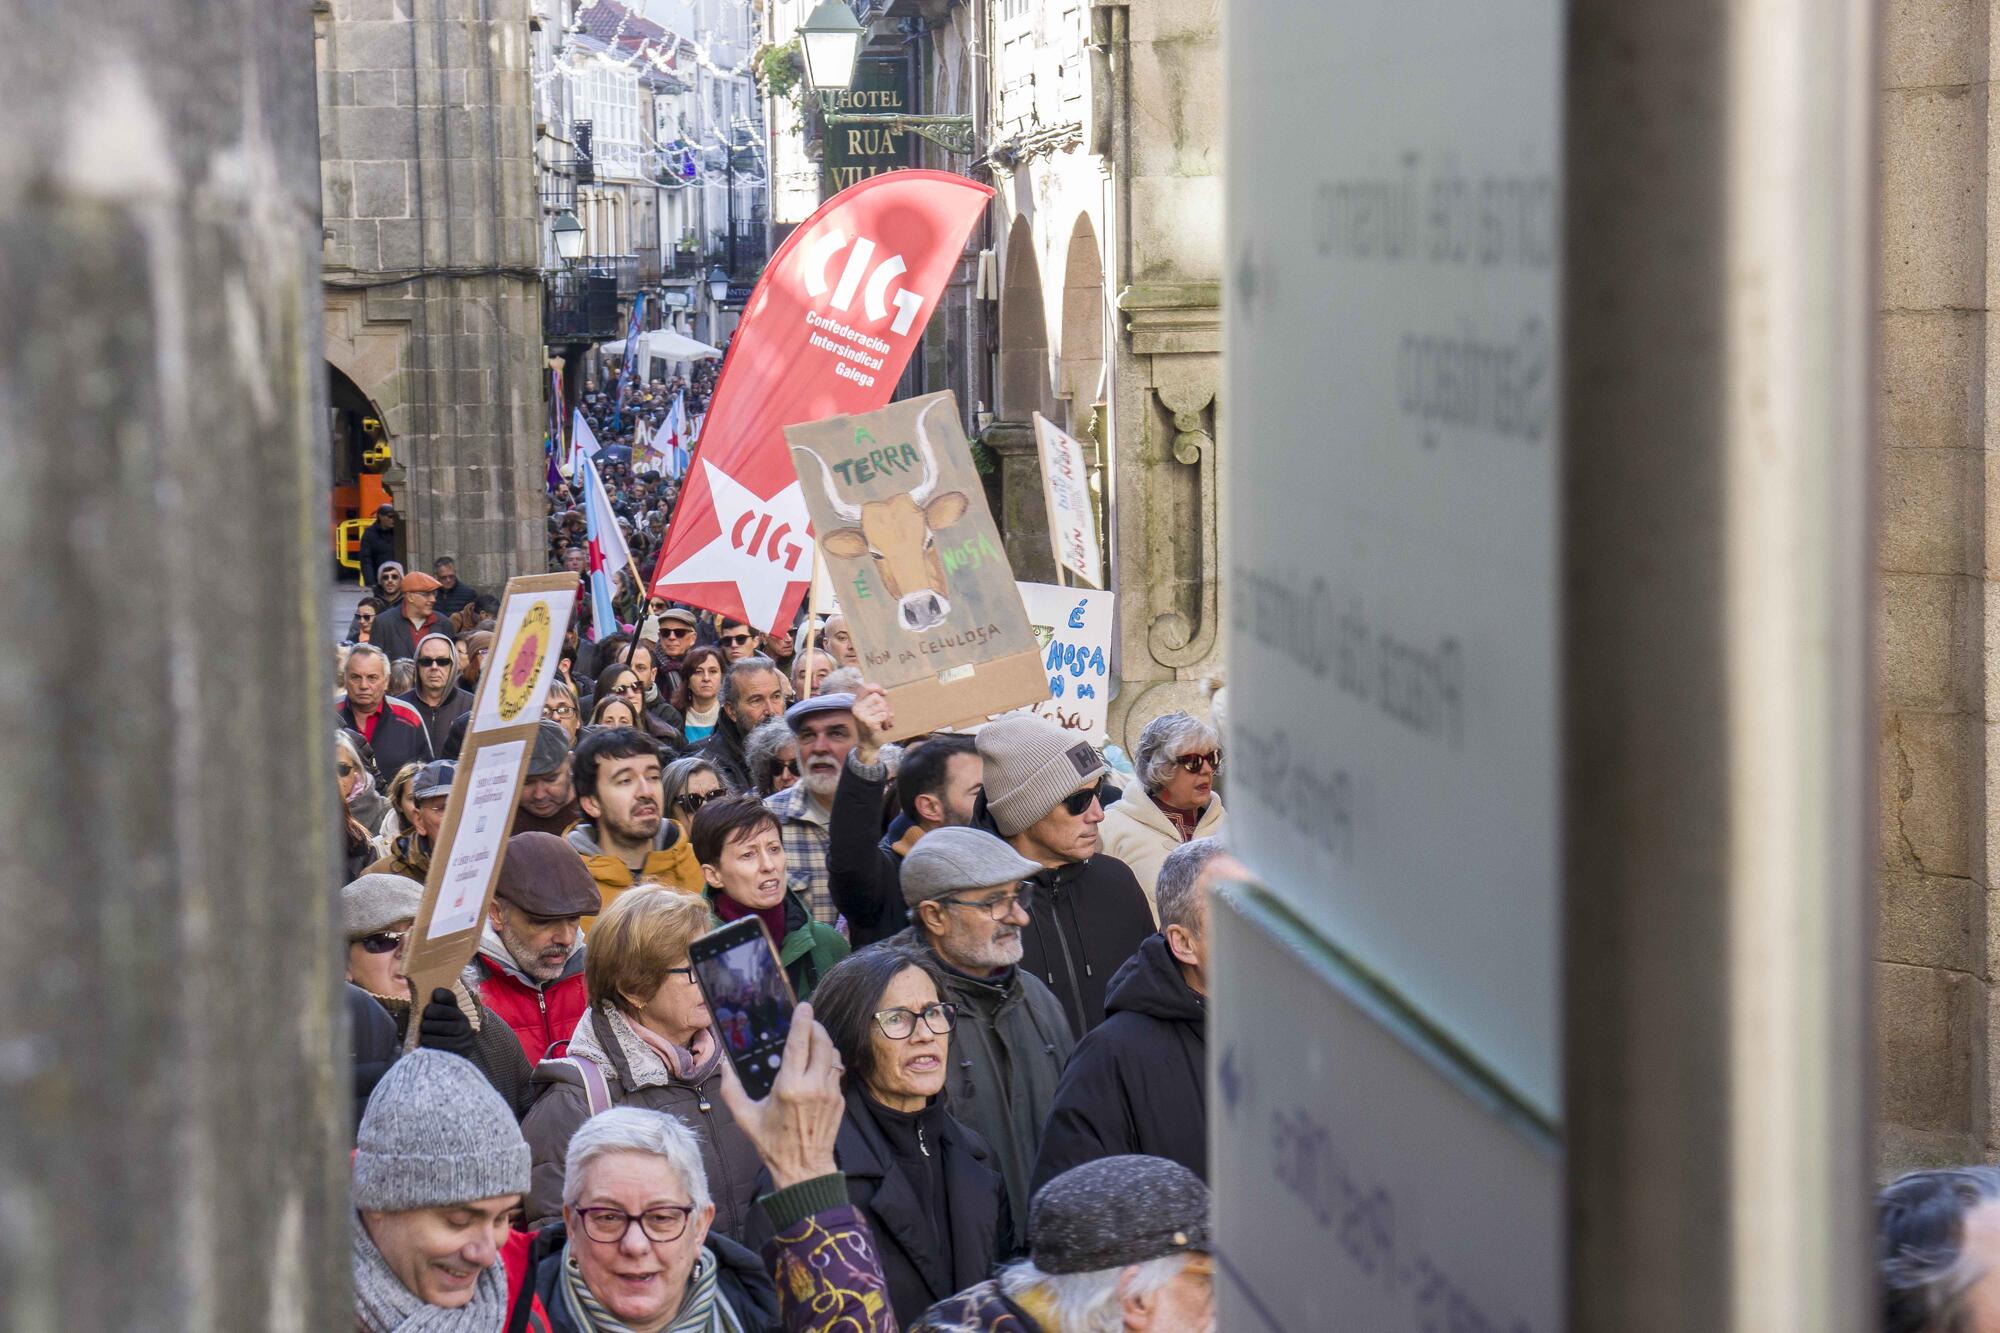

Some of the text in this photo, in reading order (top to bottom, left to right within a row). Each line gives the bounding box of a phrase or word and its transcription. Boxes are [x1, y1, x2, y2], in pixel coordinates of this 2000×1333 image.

[840, 91, 902, 107] HOTEL
[848, 129, 896, 155] RUA
[803, 229, 924, 336] CIG
[806, 310, 890, 354] Confederación
[809, 332, 884, 370] Intersindical
[835, 362, 875, 387] Galega
[854, 426, 876, 444] A
[833, 443, 920, 486] TERRA
[731, 509, 803, 572] CIG
[853, 532, 1000, 599] É NOSA
[1068, 598, 1088, 628] É
[900, 650, 916, 664] DA
[919, 623, 1001, 655] CELULOSA
[1046, 640, 1105, 677] NOSA
